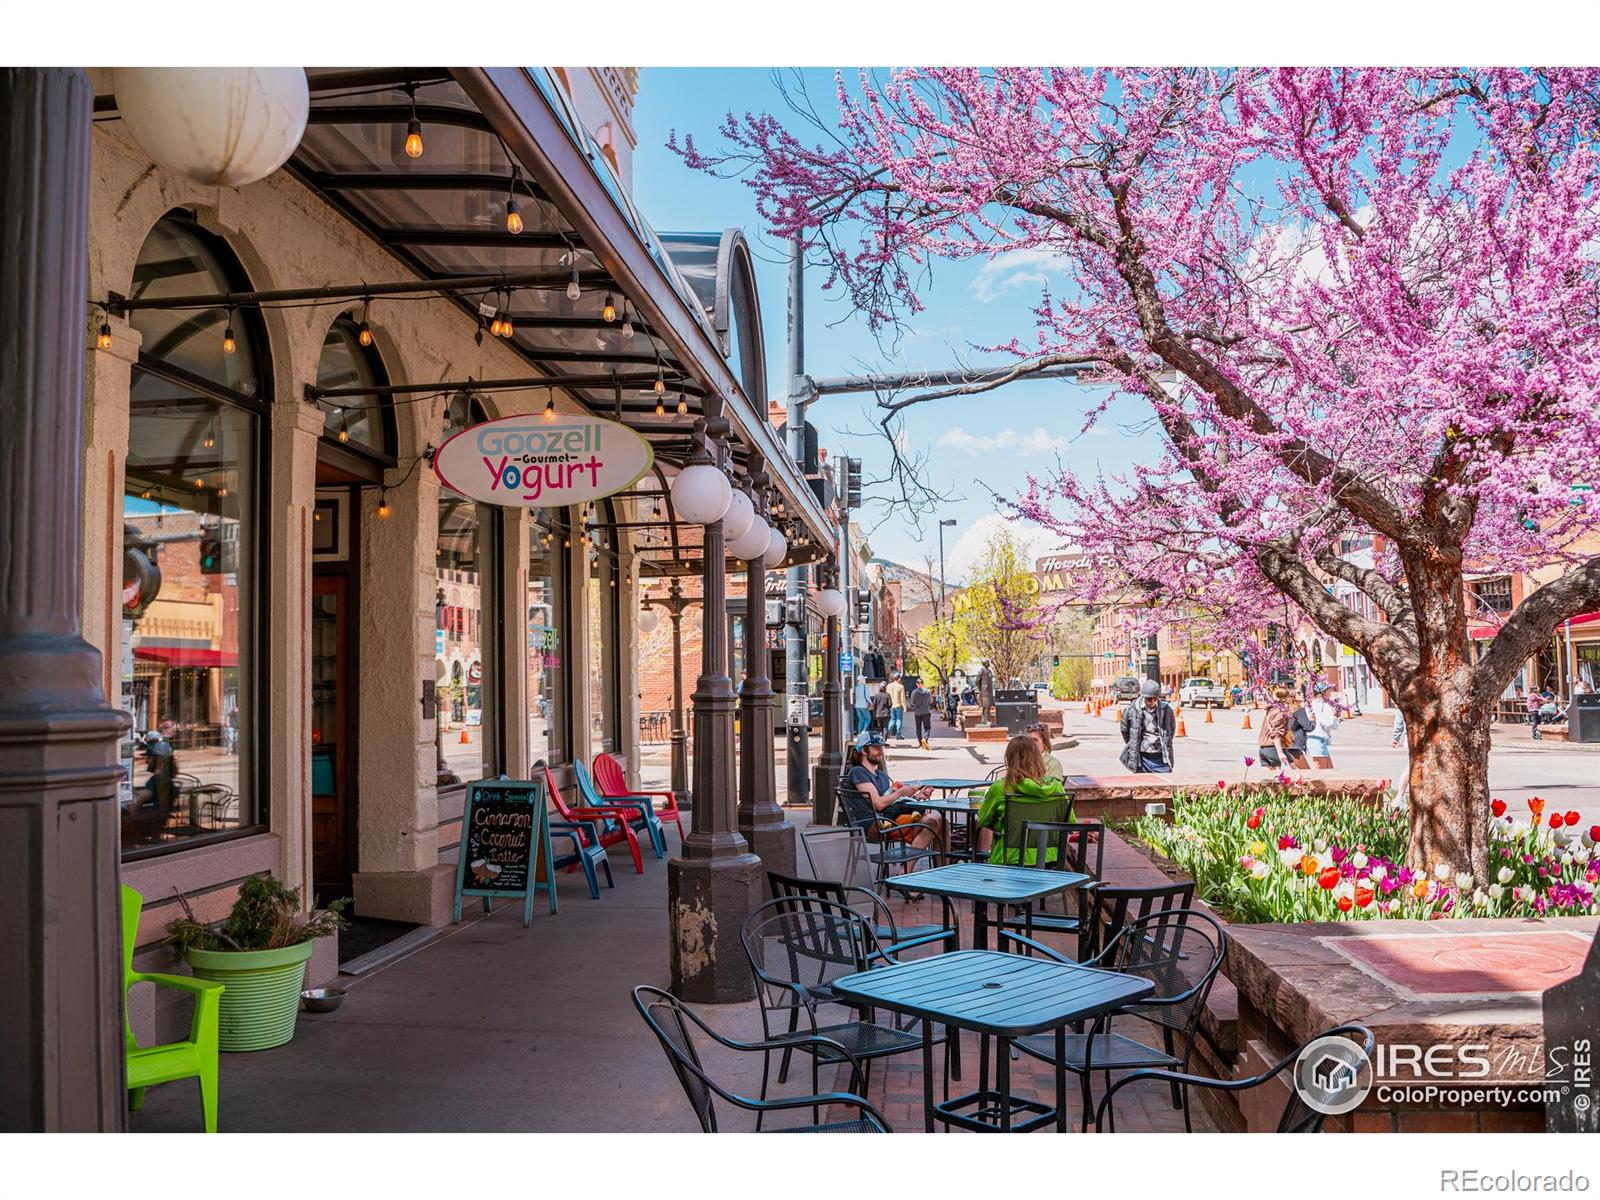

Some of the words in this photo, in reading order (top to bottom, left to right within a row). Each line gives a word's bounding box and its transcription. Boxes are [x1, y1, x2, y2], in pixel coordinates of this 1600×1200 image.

[477, 424, 602, 455] Goozell
[483, 455, 604, 500] Yogurt
[475, 808, 532, 829] Cinnamon
[481, 828, 526, 848] Coconut
